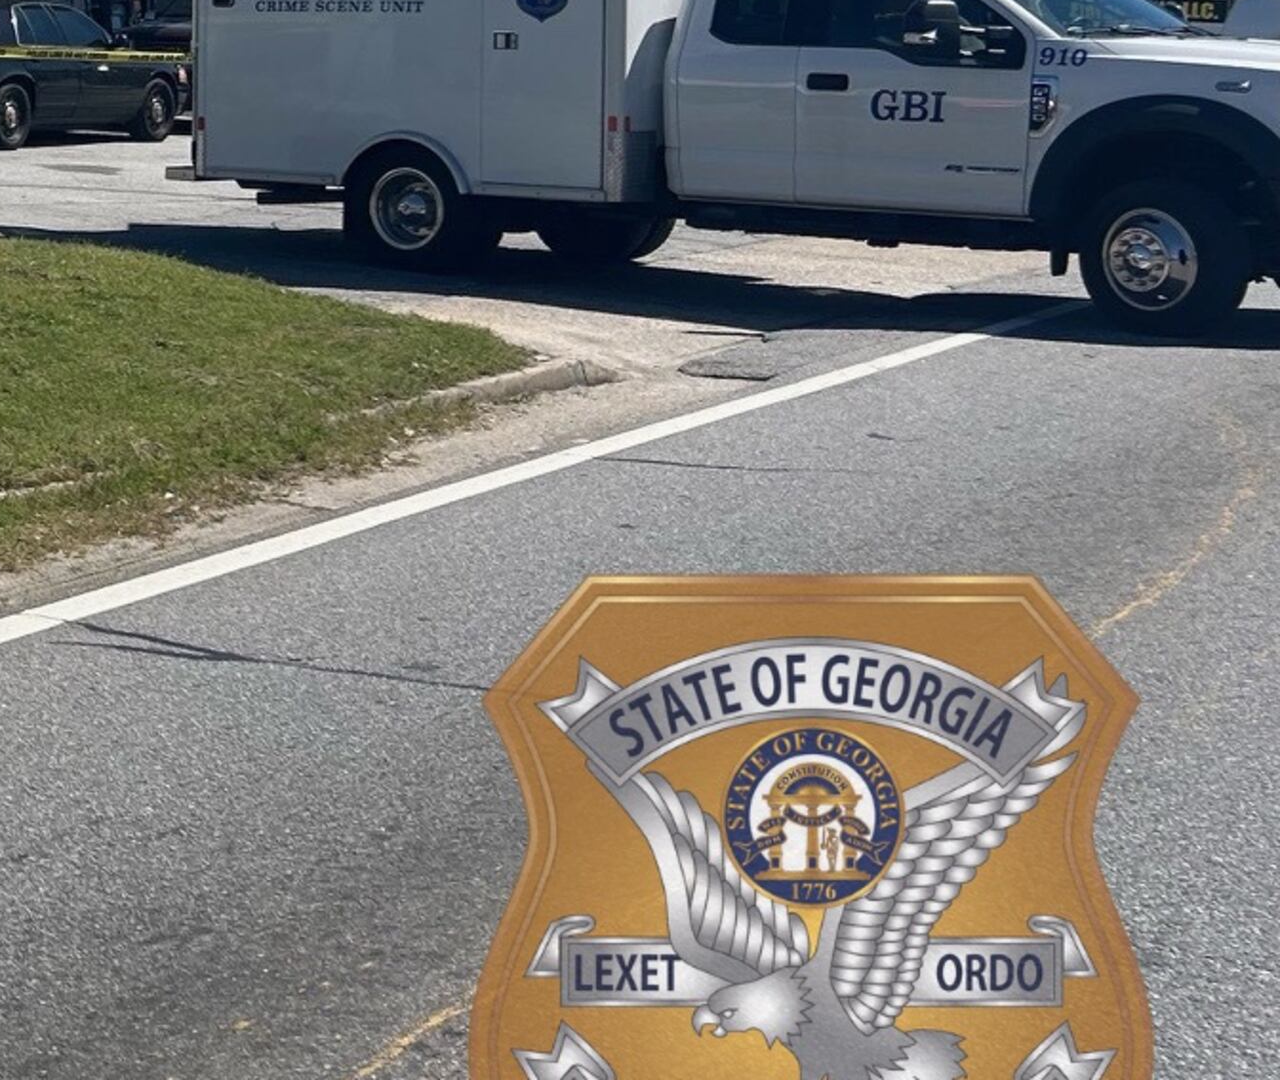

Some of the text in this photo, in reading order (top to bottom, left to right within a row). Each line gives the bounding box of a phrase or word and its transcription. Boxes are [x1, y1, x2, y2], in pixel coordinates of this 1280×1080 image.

[254, 0, 425, 13] CRIME SCENE UNIT
[1039, 46, 1088, 67] 910
[870, 89, 947, 124] GBI
